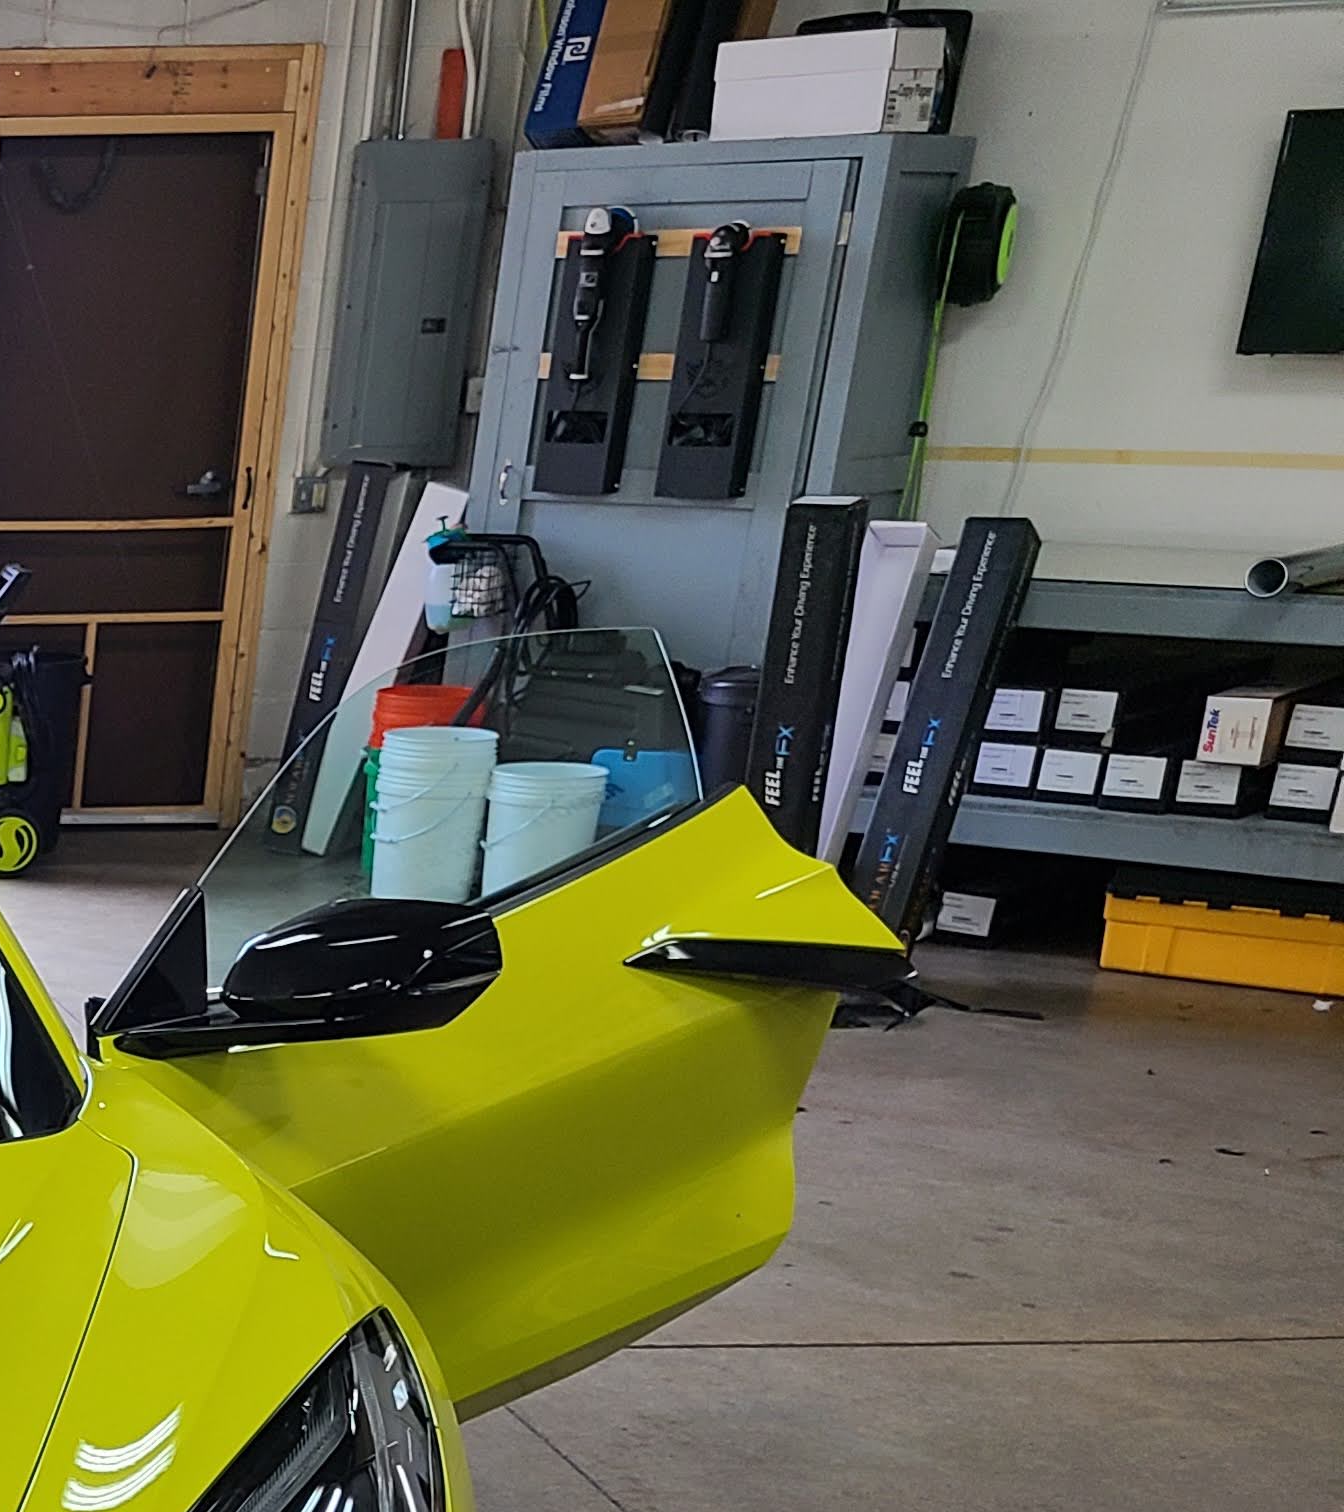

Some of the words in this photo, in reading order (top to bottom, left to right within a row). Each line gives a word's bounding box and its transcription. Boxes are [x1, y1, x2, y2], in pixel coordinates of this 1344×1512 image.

[544, 39, 565, 80] Window
[534, 83, 552, 112] Films
[800, 525, 817, 579] Experience
[972, 530, 997, 582] Experience
[794, 581, 811, 617] Driving
[961, 582, 983, 616] Driving
[791, 618, 803, 639] Your
[954, 617, 969, 638] Your
[784, 642, 800, 684] Enhance
[941, 639, 963, 679] Enhance
[1203, 709, 1220, 752] SunTek
[765, 770, 781, 806] FEEL
[775, 725, 795, 756] FX
[902, 759, 924, 794] FEEL
[921, 718, 942, 747] FX
